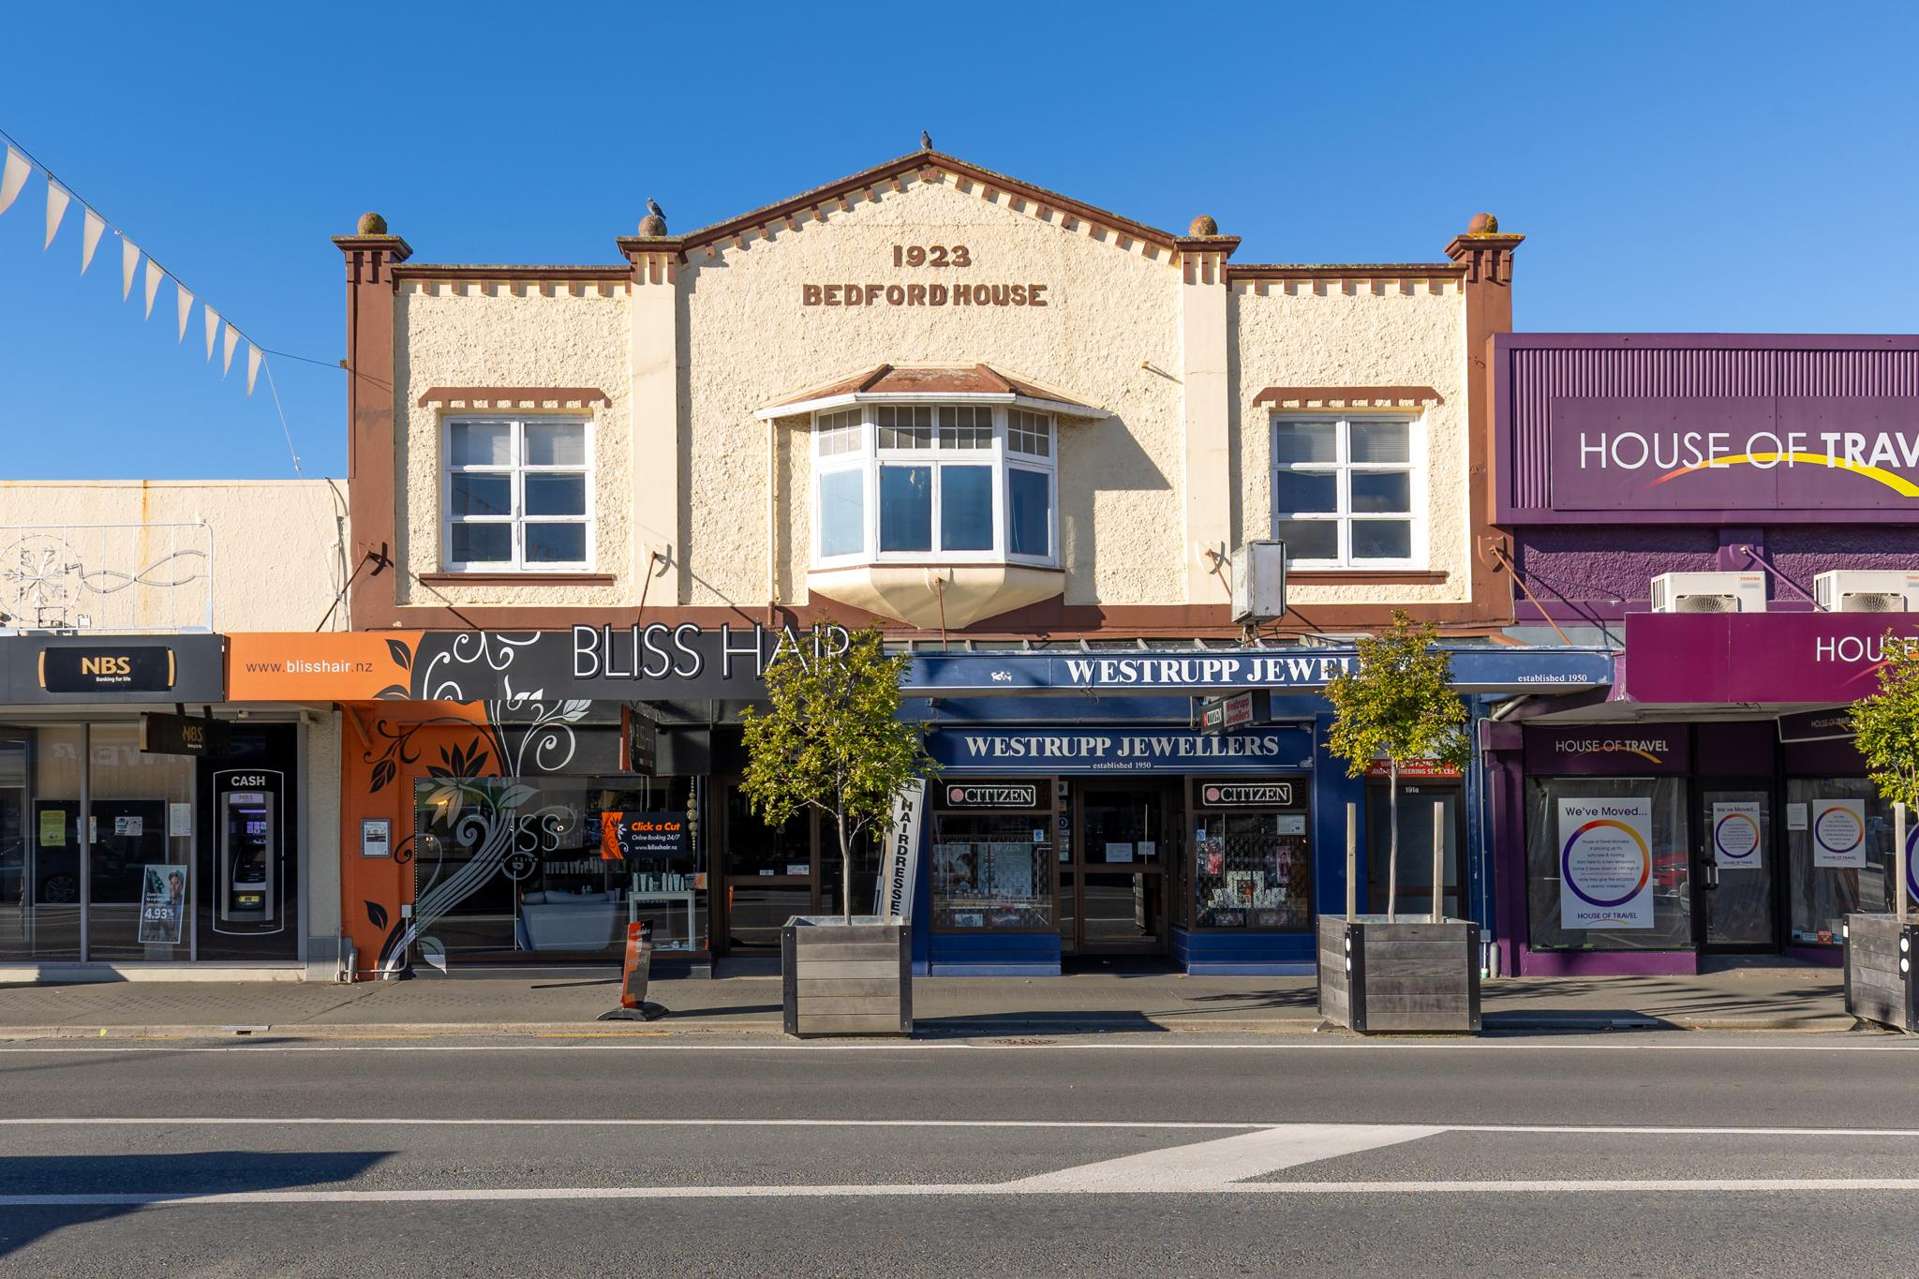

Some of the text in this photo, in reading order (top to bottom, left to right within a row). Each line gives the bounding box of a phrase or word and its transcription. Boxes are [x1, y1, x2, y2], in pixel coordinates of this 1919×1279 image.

[893, 245, 972, 267] 1923
[803, 284, 1048, 306] BEDFORD HOUSE
[1580, 432, 1730, 469] HOUSE
[1746, 432, 1807, 469] OF
[573, 623, 850, 679] BLISS HAIR
[1816, 636, 1919, 663] HOUE
[81, 656, 131, 675] NBS
[246, 660, 374, 673] www.blisshair.nz
[1065, 658, 1239, 683] WESTRUPP
[1518, 673, 1587, 682] established 1950
[965, 735, 1279, 757] WESTRUPP JEWELLERS
[1555, 740, 1669, 752] HOUSE OF TRAVEL
[231, 776, 266, 786] CASH
[965, 788, 1032, 802] CITIZEN
[1220, 787, 1288, 802] CITIZEN
[1565, 807, 1598, 816] We've
[632, 822, 653, 831] Click
[664, 822, 680, 831] Cut
